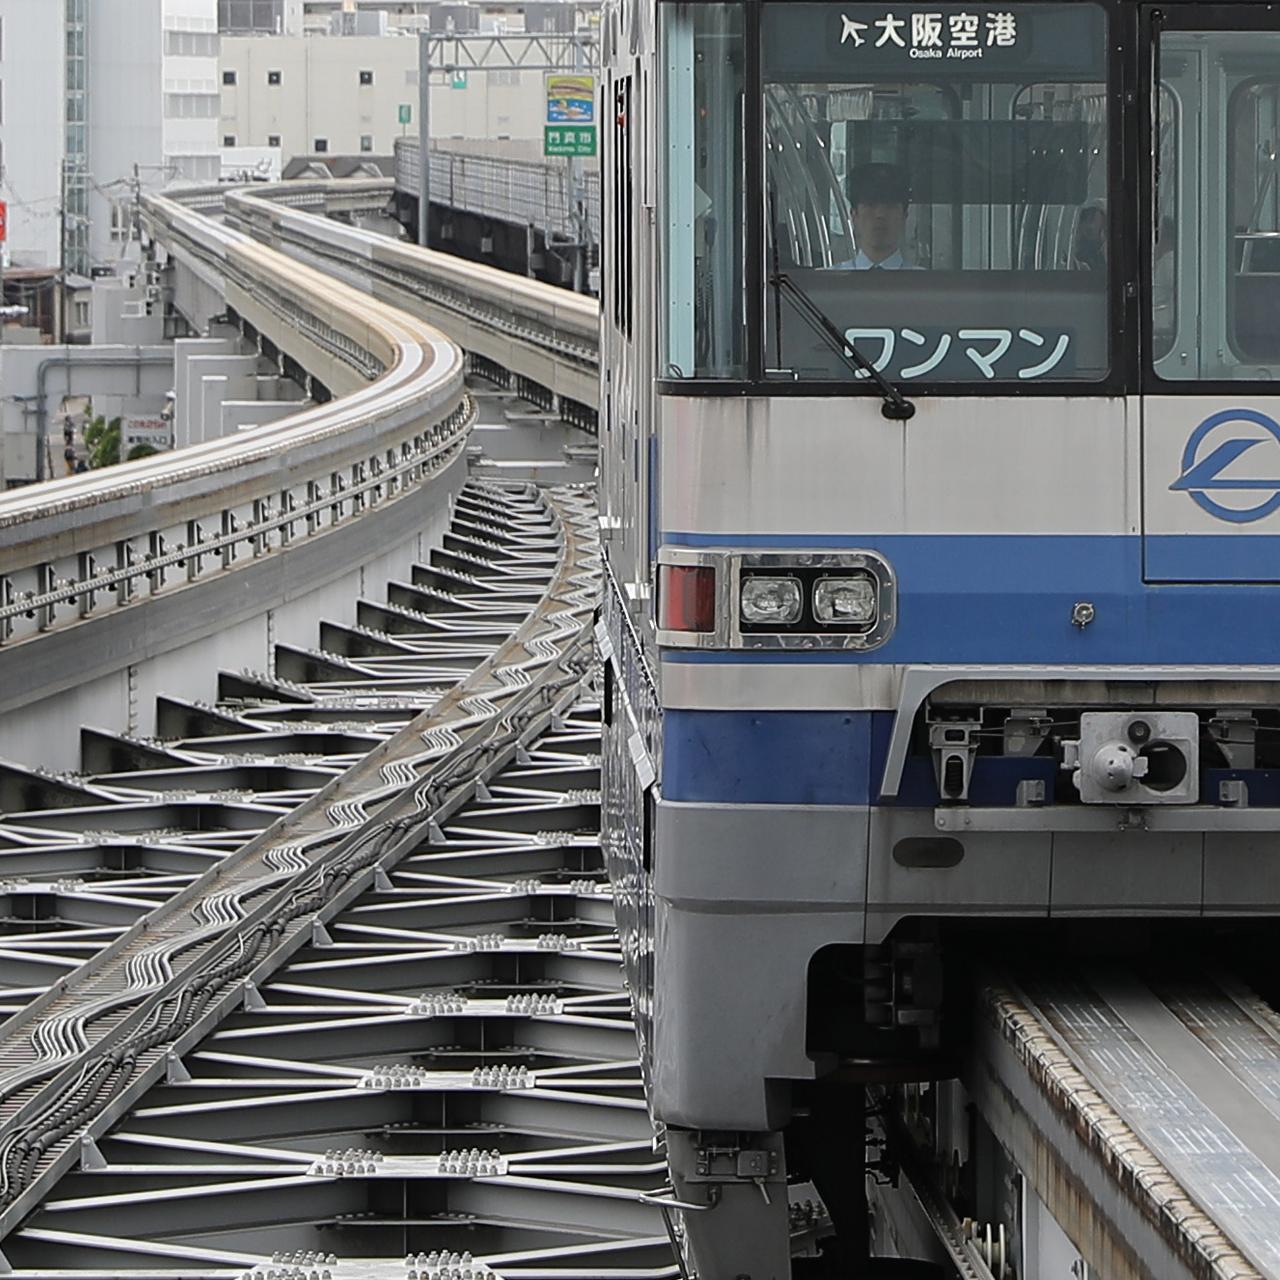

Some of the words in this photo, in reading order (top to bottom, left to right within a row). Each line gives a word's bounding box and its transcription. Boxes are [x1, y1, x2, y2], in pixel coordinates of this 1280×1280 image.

[874, 12, 1017, 48] 大阪空港
[909, 48, 942, 59] Osaka
[946, 48, 983, 60] Airport
[548, 131, 592, 145] 門真市
[845, 328, 1070, 379] ワンマン
